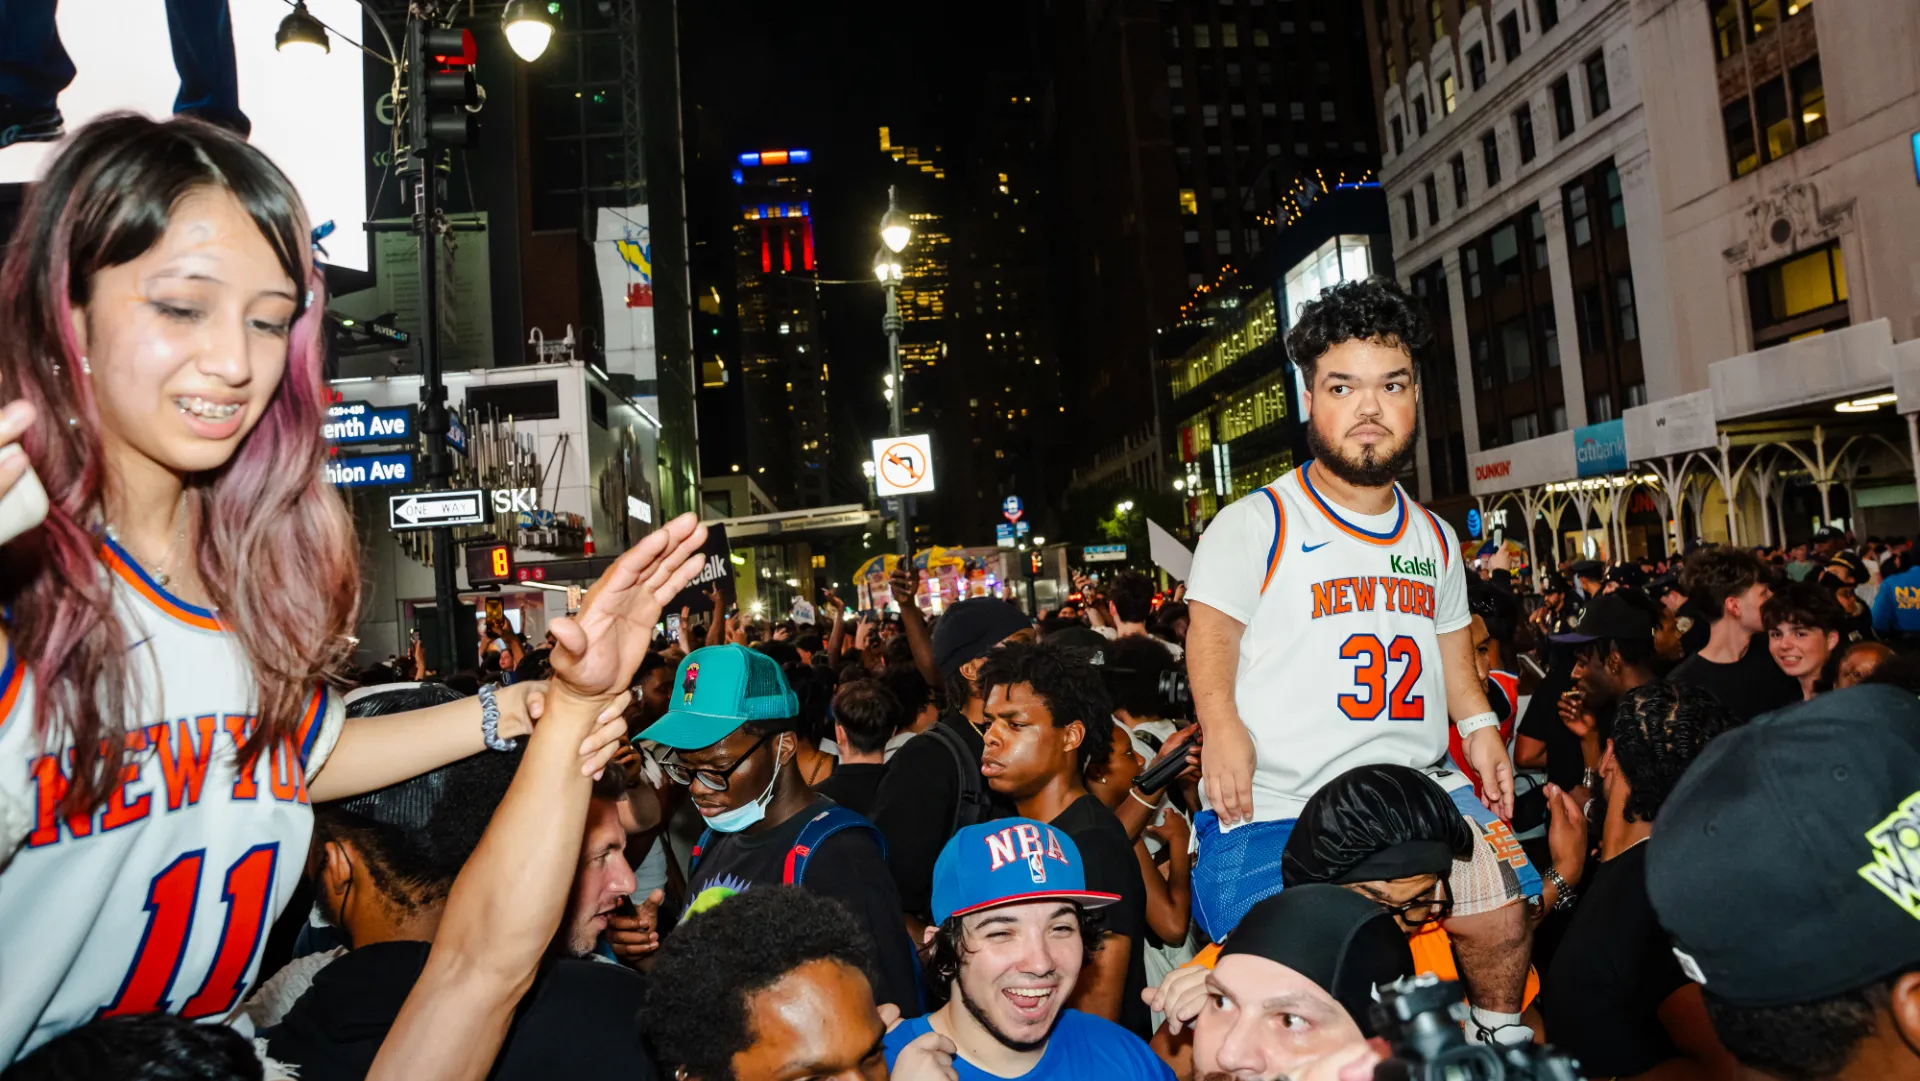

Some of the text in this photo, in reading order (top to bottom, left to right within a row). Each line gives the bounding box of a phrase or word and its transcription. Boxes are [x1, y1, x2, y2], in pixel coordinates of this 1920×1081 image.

[322, 416, 405, 439] enth Ave
[1577, 437, 1625, 463] citibank
[323, 461, 406, 484] hion Ave
[1475, 460, 1512, 481] DUNKIN'
[405, 503, 467, 517] ONE WAY
[1390, 553, 1438, 579] Kalsh
[1310, 576, 1378, 620] NEW
[1337, 633, 1425, 722] 32
[25, 713, 310, 849] NEW YO
[984, 823, 1070, 873] NBA
[98, 841, 281, 1020] 11
